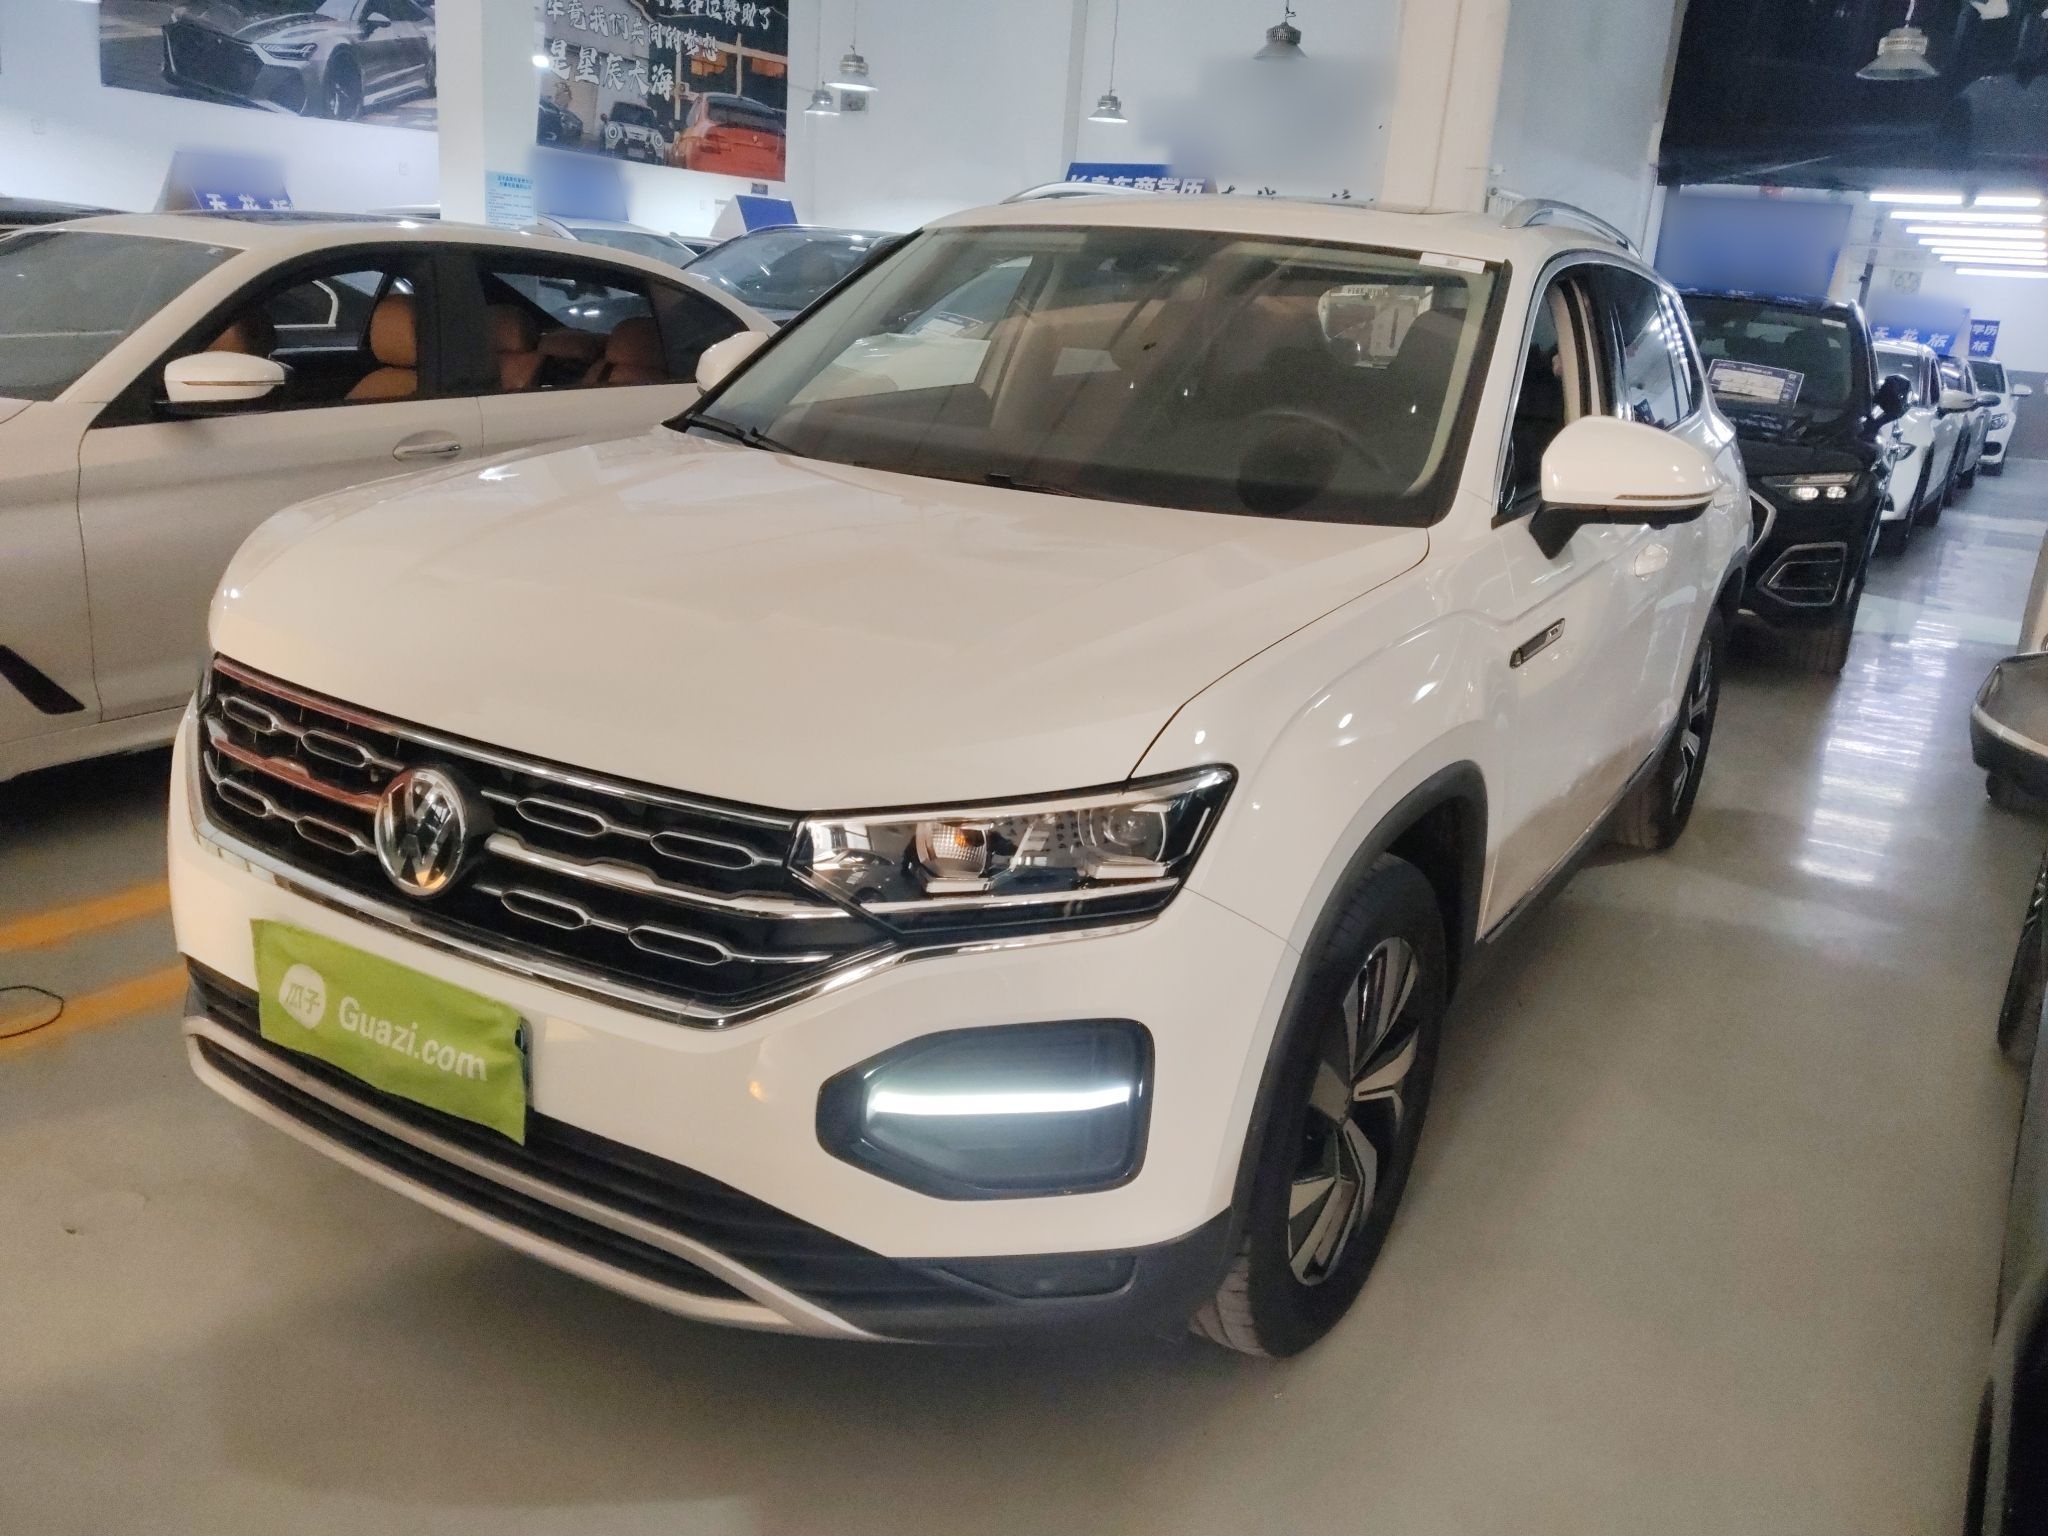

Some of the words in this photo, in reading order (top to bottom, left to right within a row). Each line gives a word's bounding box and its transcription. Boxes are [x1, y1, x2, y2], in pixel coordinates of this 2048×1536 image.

[550, 39, 675, 102] 是星辰大海
[284, 981, 321, 1015] 瓜子
[338, 996, 488, 1082] Guazi.com
